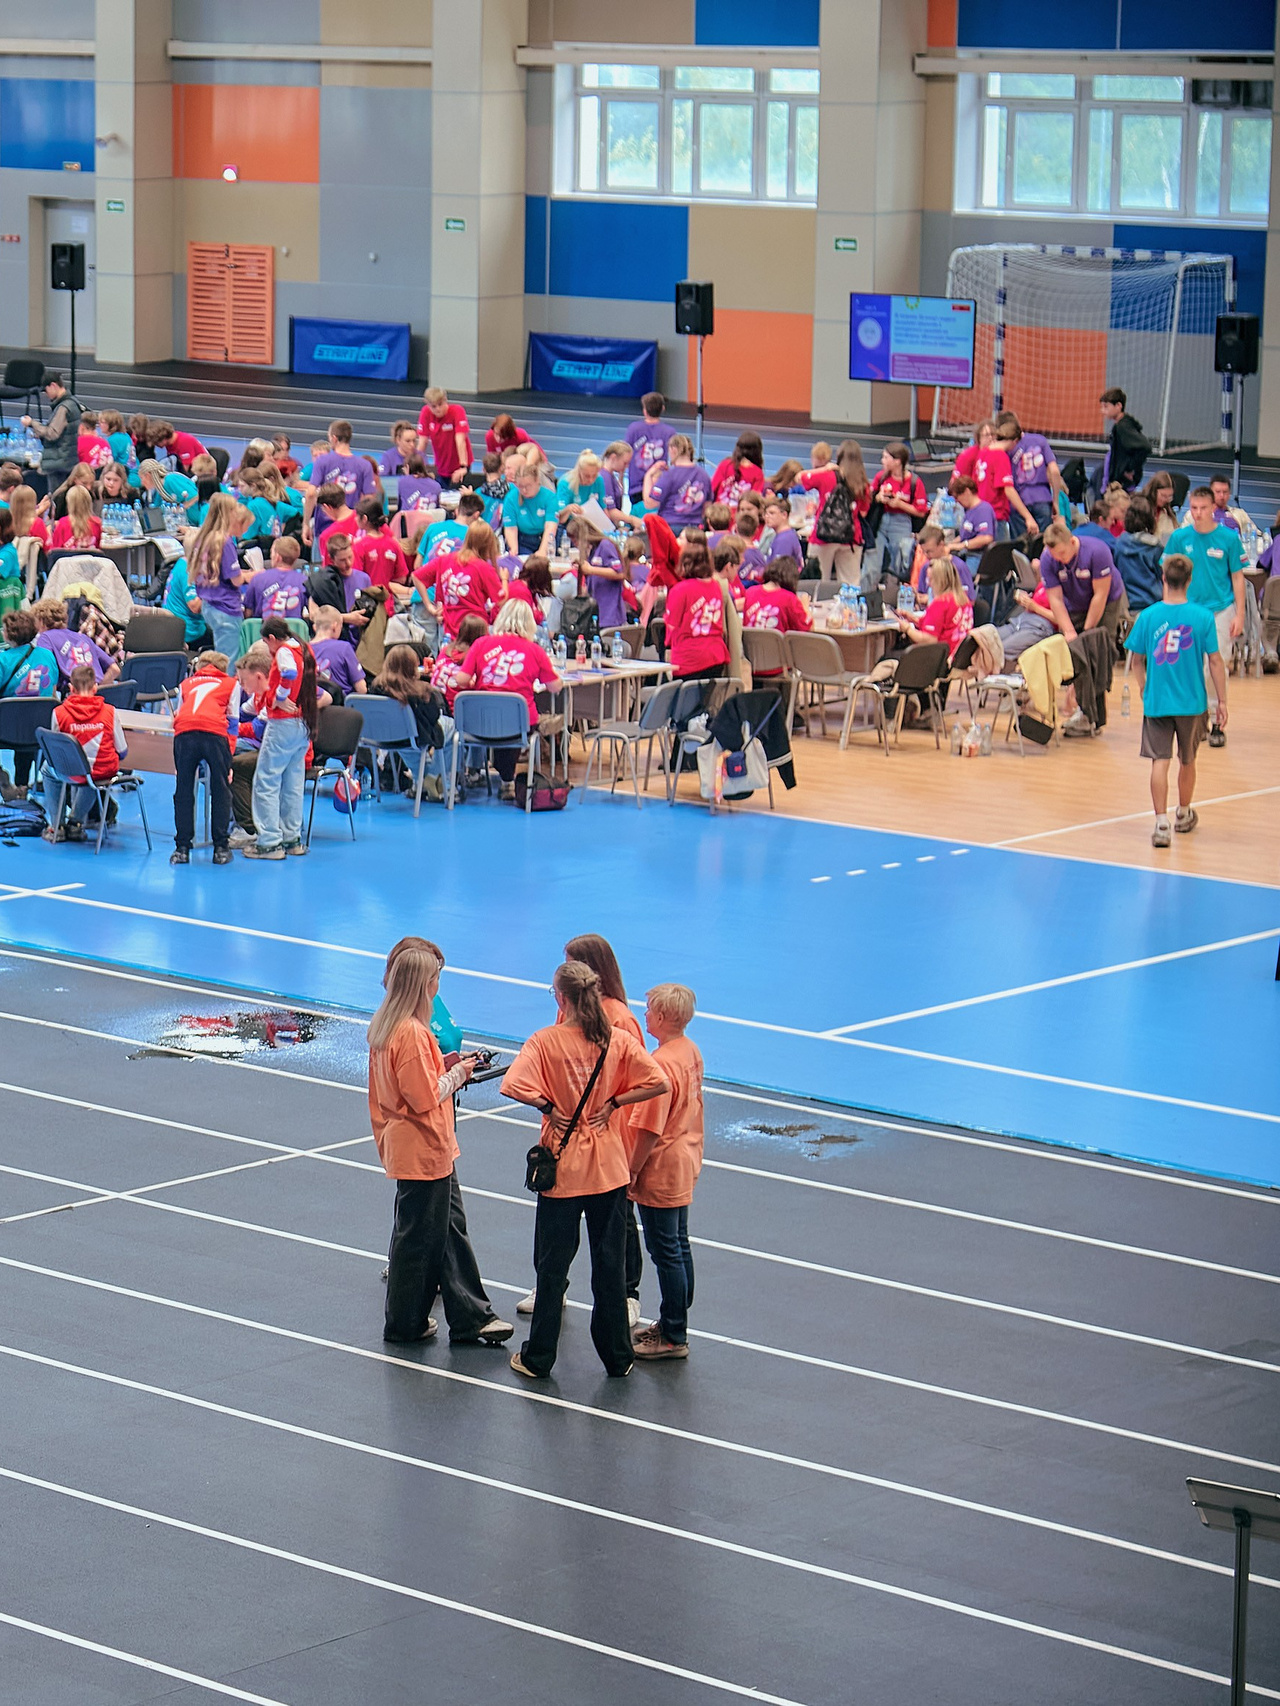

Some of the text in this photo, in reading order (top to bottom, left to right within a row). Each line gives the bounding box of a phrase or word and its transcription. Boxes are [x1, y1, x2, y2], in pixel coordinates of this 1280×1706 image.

[316, 345, 387, 362] START LINE
[554, 362, 632, 379] START LINE
[438, 538, 456, 556] 5
[273, 591, 288, 610] 5
[1166, 630, 1181, 653] 5
[73, 647, 85, 663] 5
[495, 655, 512, 676] 5
[28, 670, 41, 690] 5
[70, 722, 104, 733] Первые
